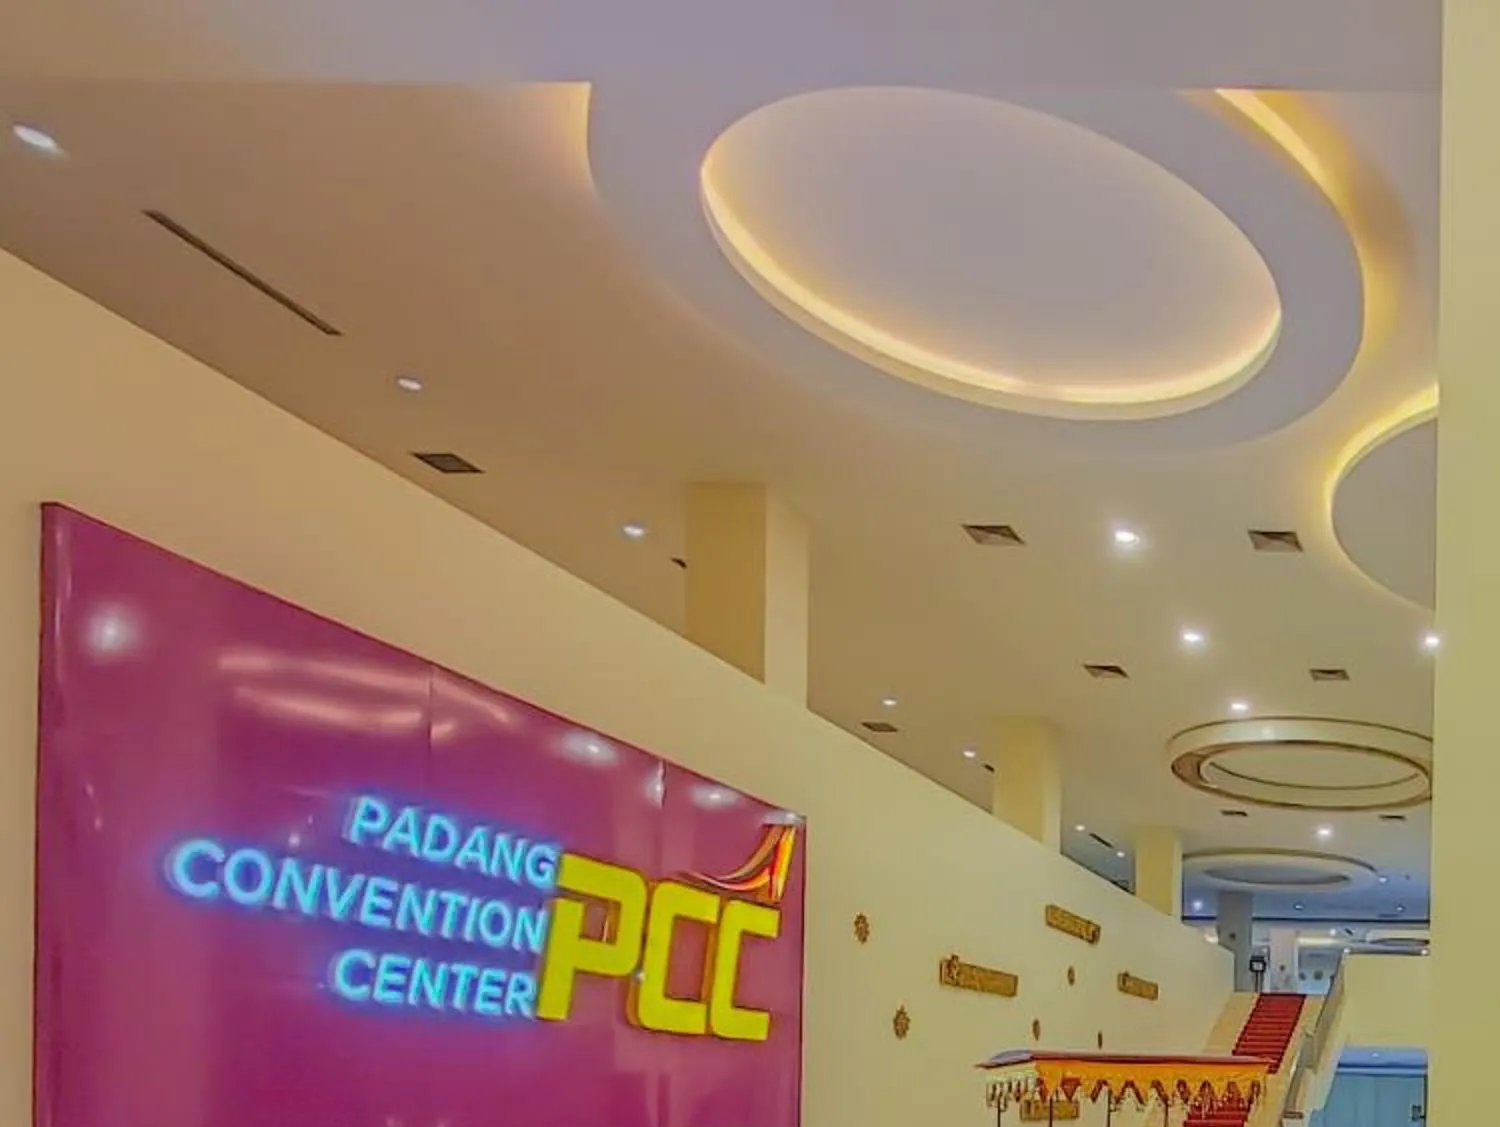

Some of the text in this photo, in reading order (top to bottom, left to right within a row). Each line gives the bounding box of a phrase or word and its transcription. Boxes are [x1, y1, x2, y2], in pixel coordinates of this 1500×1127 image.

[346, 796, 559, 889] PADANG
[168, 839, 549, 953] CONVENTION
[536, 853, 780, 1040] PCC
[332, 949, 539, 1019] CENTER
